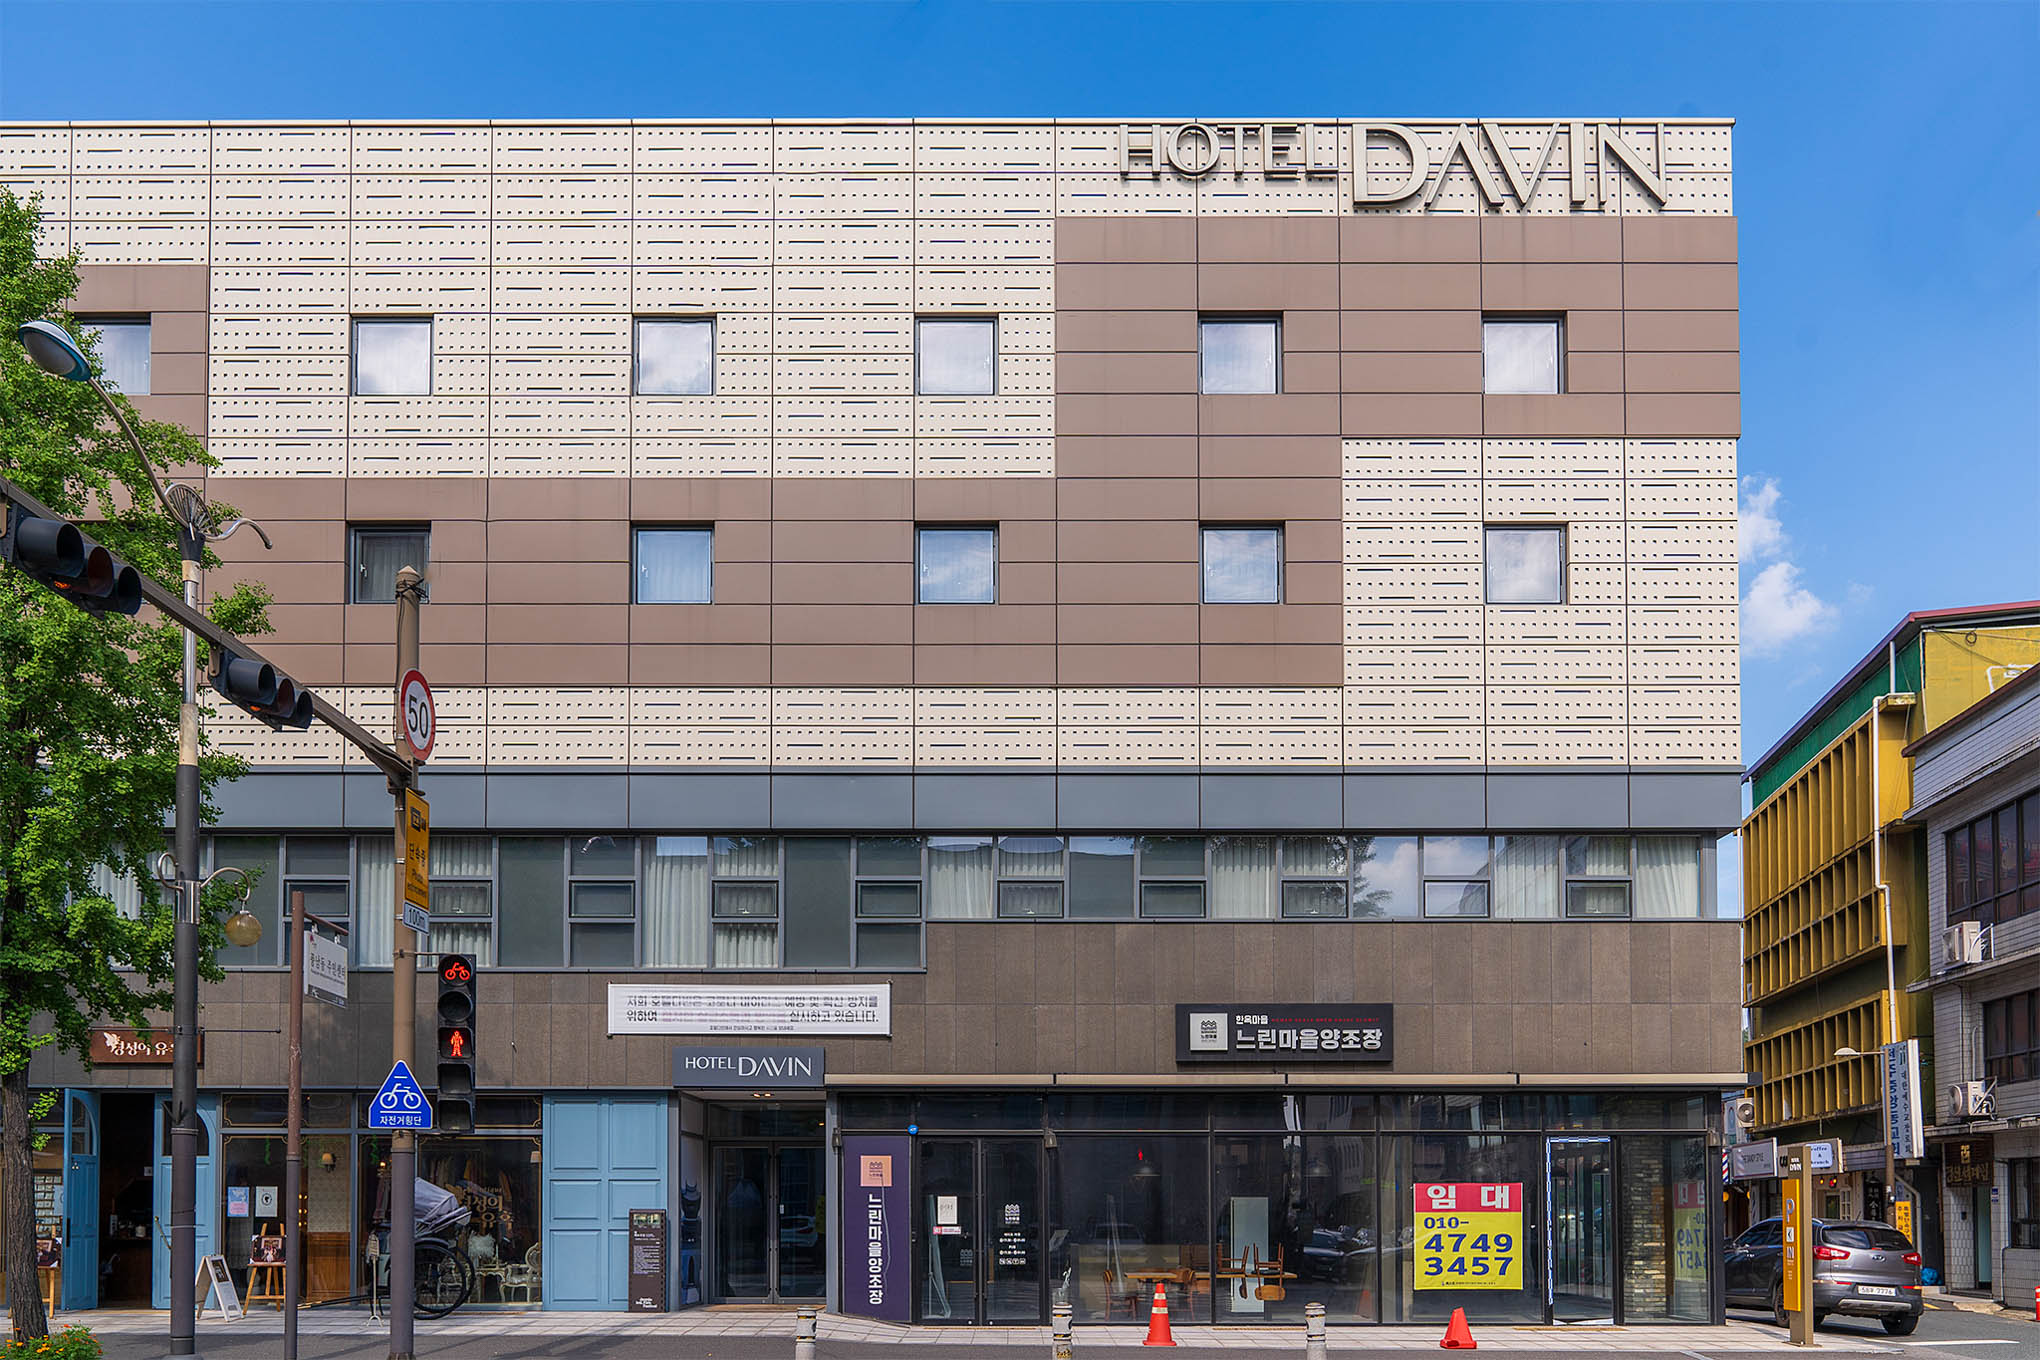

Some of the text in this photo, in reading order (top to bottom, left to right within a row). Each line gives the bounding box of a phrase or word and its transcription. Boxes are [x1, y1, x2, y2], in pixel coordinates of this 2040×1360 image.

[1119, 122, 1669, 207] HOTEL DAVIN
[407, 694, 428, 739] 50
[835, 1009, 879, 1023] 있습니다.
[1235, 1014, 1269, 1025] 한옥마을
[155, 1041, 174, 1056] 유
[1235, 1028, 1383, 1050] 느린마을양조장
[685, 1056, 812, 1077] HOTEL DAVIN
[379, 1115, 422, 1126] 자전거횡단
[1785, 1197, 1796, 1223] P
[1423, 1217, 1470, 1229] 010-
[868, 1194, 884, 1304] 느린마을양조장
[1423, 1233, 1514, 1253] 4749
[1786, 1246, 1795, 1260] IN
[1423, 1256, 1514, 1276] 3457
